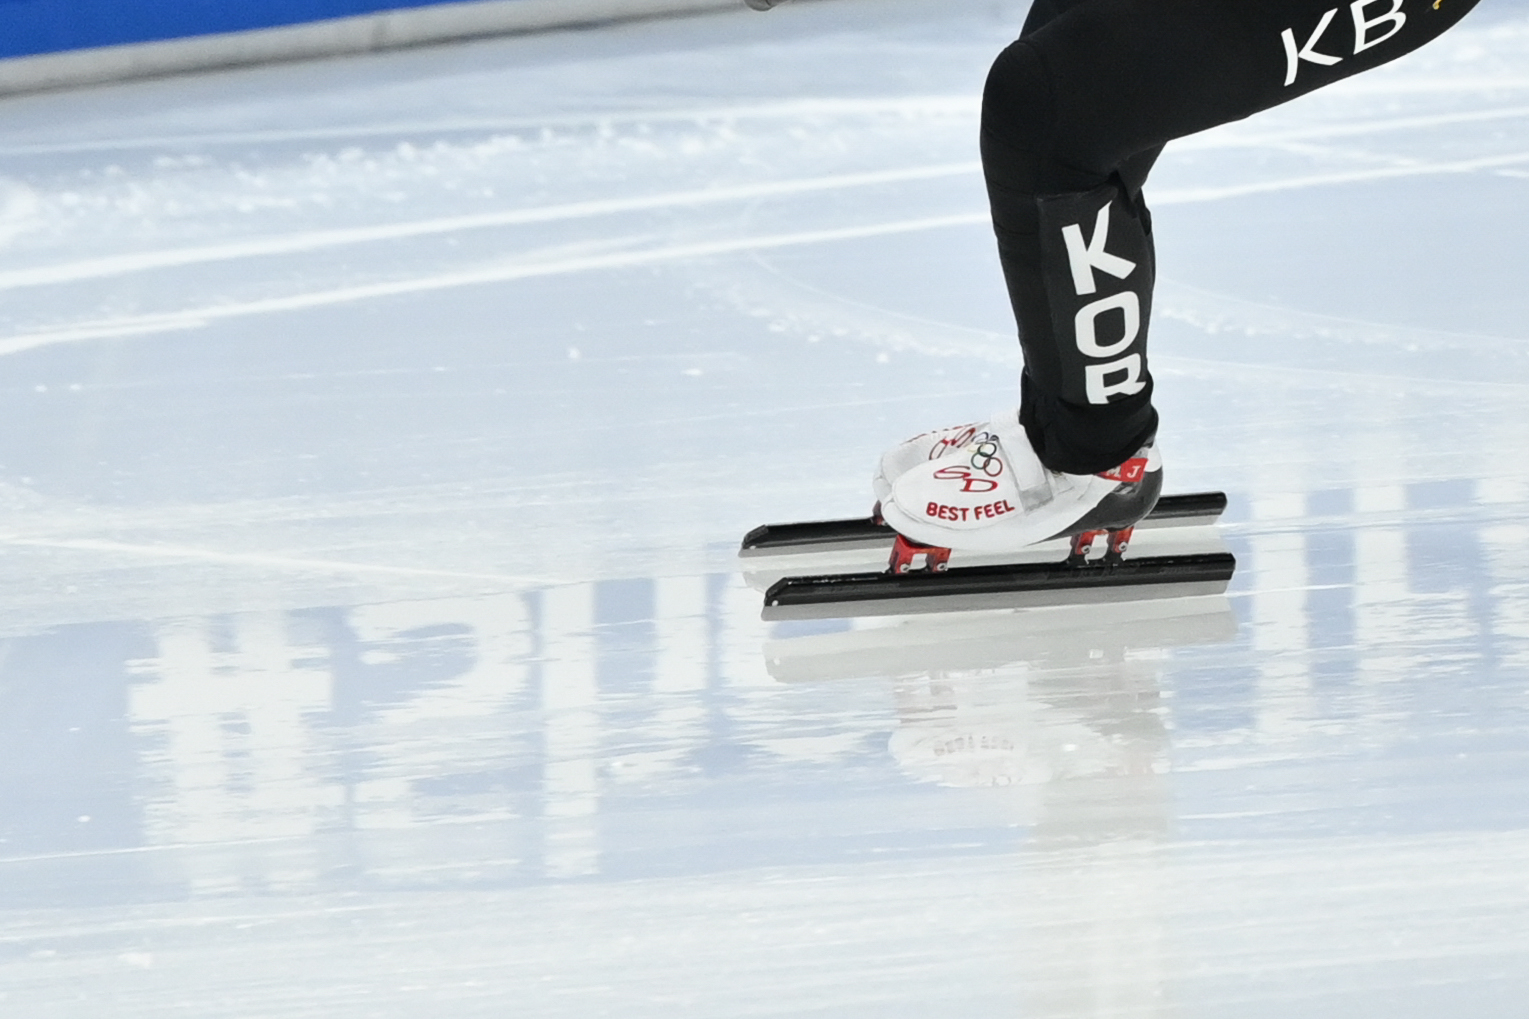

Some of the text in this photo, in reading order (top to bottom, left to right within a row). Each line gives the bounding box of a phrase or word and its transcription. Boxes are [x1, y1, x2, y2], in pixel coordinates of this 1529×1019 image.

[1061, 200, 1146, 405] KOR
[925, 499, 1016, 522] BEST FEEL
